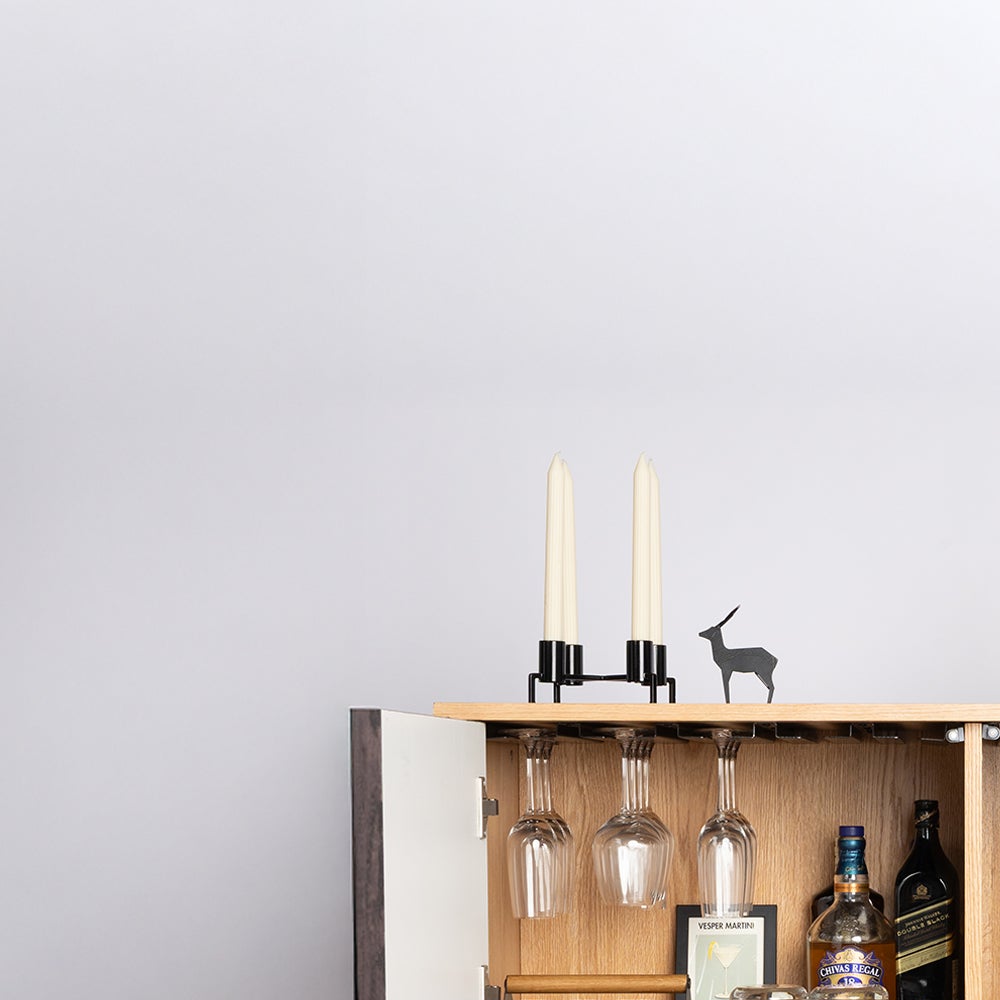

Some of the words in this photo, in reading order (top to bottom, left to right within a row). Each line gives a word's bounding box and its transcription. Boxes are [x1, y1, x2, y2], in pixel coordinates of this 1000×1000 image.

[698, 922, 724, 930] VESPER
[725, 922, 755, 930] MARTINI
[896, 922, 925, 937] DOUBLE
[926, 913, 950, 926] BLACK
[820, 964, 850, 977] CHIVAS
[852, 964, 880, 977] REGAL
